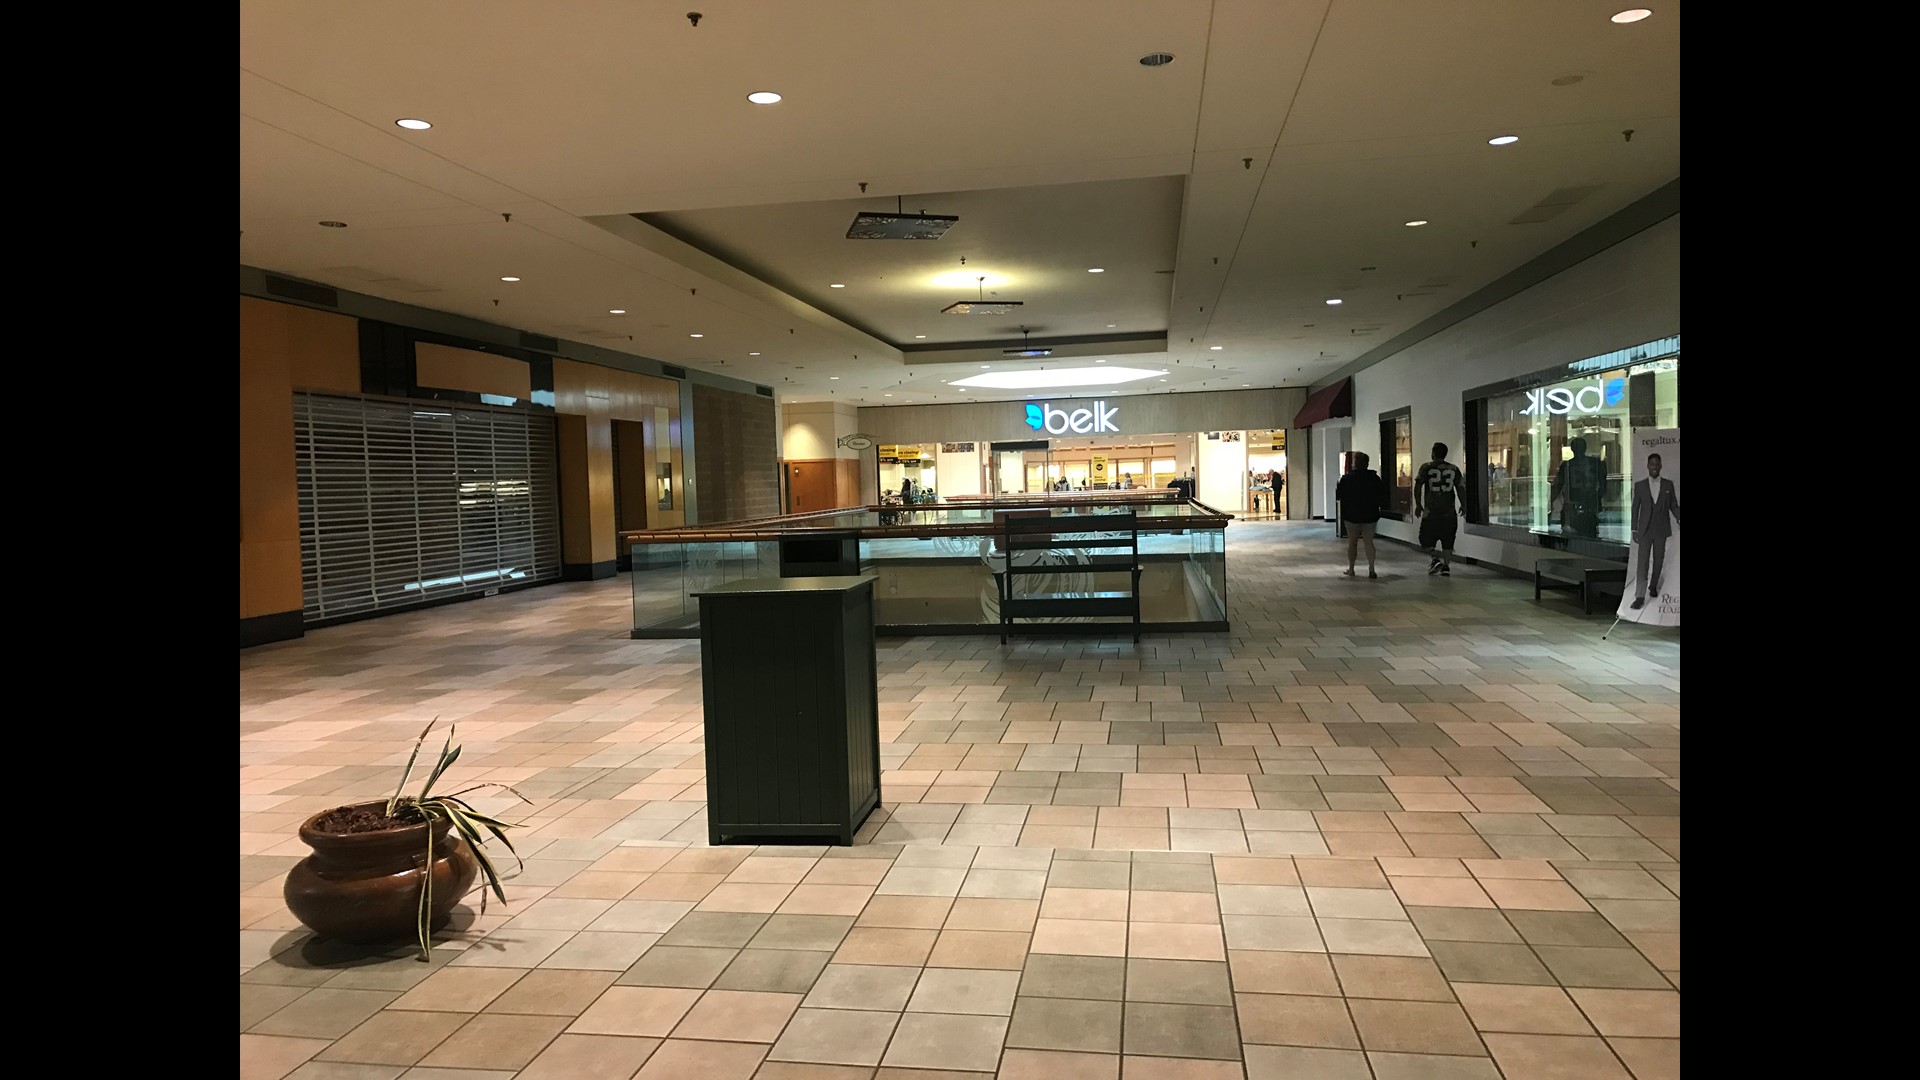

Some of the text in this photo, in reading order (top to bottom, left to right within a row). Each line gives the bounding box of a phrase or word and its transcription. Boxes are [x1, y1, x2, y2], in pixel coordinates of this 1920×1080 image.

[1044, 400, 1119, 434] belk
[1642, 436, 1680, 448] regaltux.
[1428, 468, 1455, 492] 23
